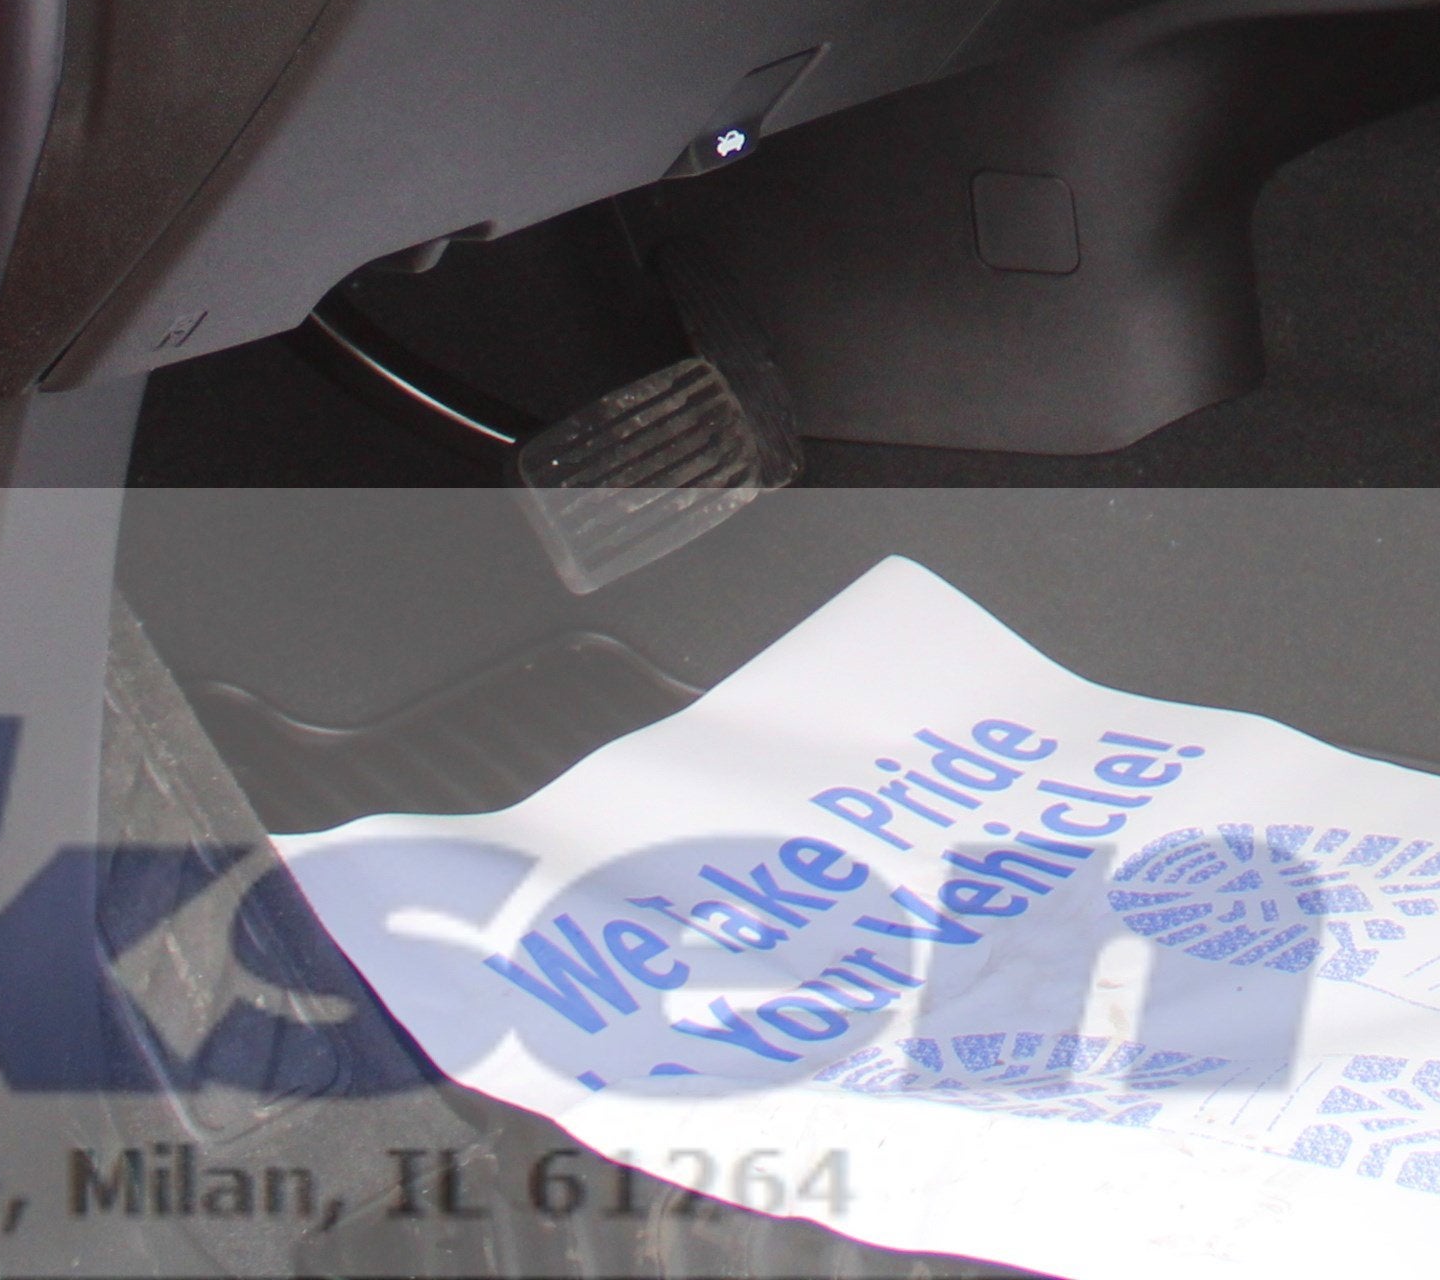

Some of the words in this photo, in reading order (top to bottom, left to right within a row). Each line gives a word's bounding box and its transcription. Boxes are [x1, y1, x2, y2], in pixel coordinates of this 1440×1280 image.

[482, 913, 691, 1034] We
[809, 717, 1058, 852] Pride
[671, 946, 927, 1064] Your
[852, 730, 1206, 946] Vehicle!
